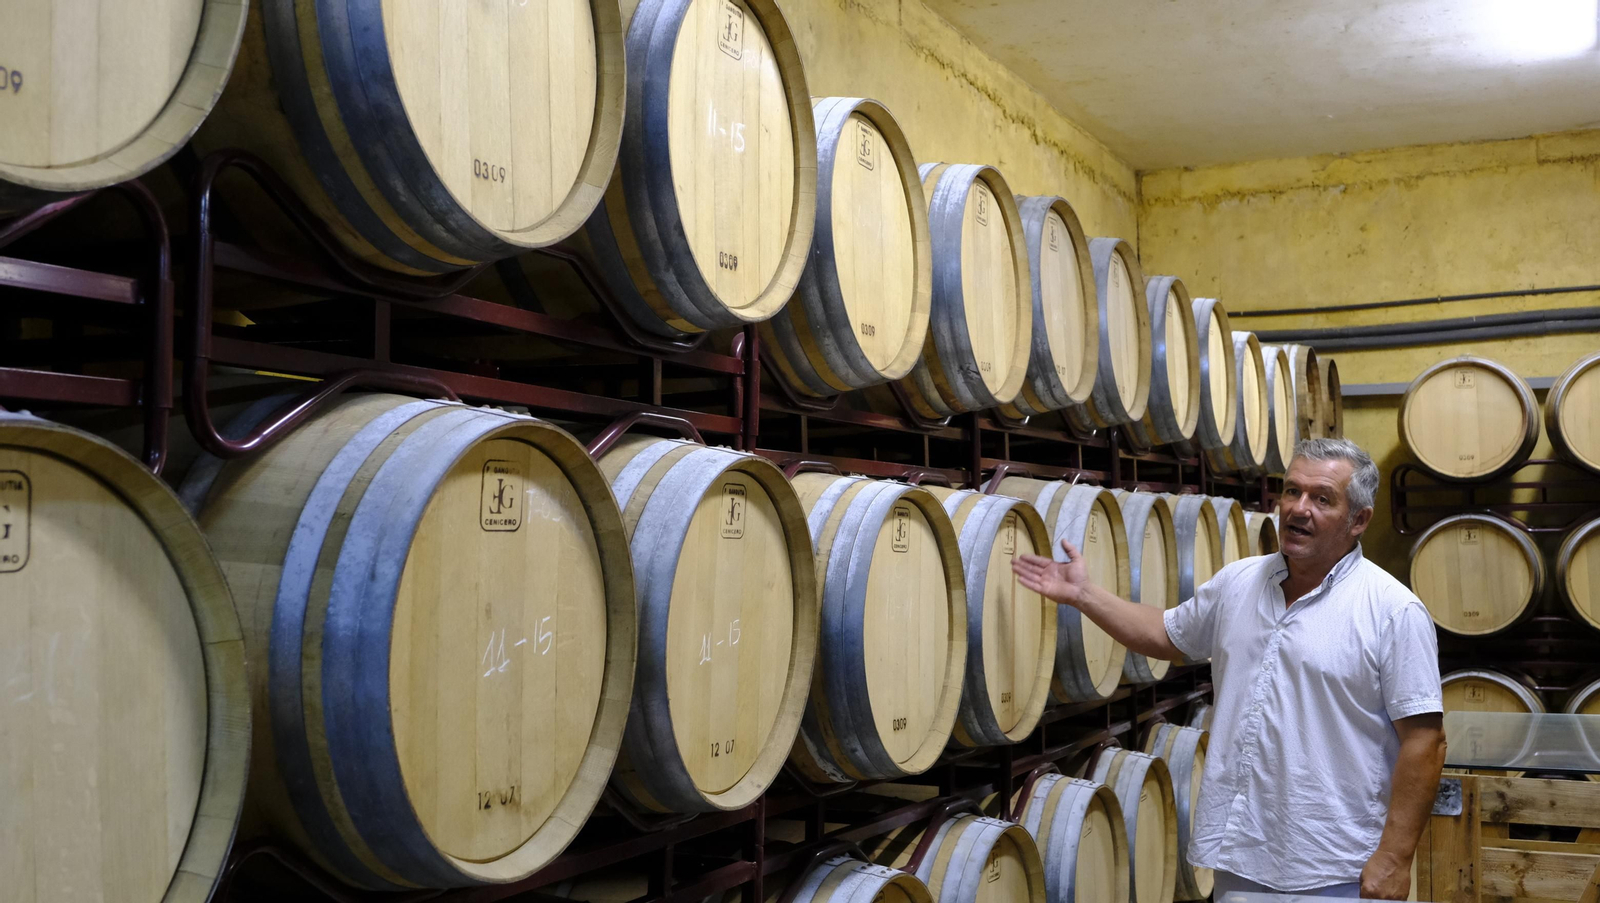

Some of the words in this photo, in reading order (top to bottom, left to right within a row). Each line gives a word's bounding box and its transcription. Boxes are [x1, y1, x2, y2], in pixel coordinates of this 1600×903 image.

[474, 158, 506, 183] 0309
[719, 251, 738, 271] 0309
[484, 518, 517, 527] CENICERO
[892, 717, 908, 731] 0309
